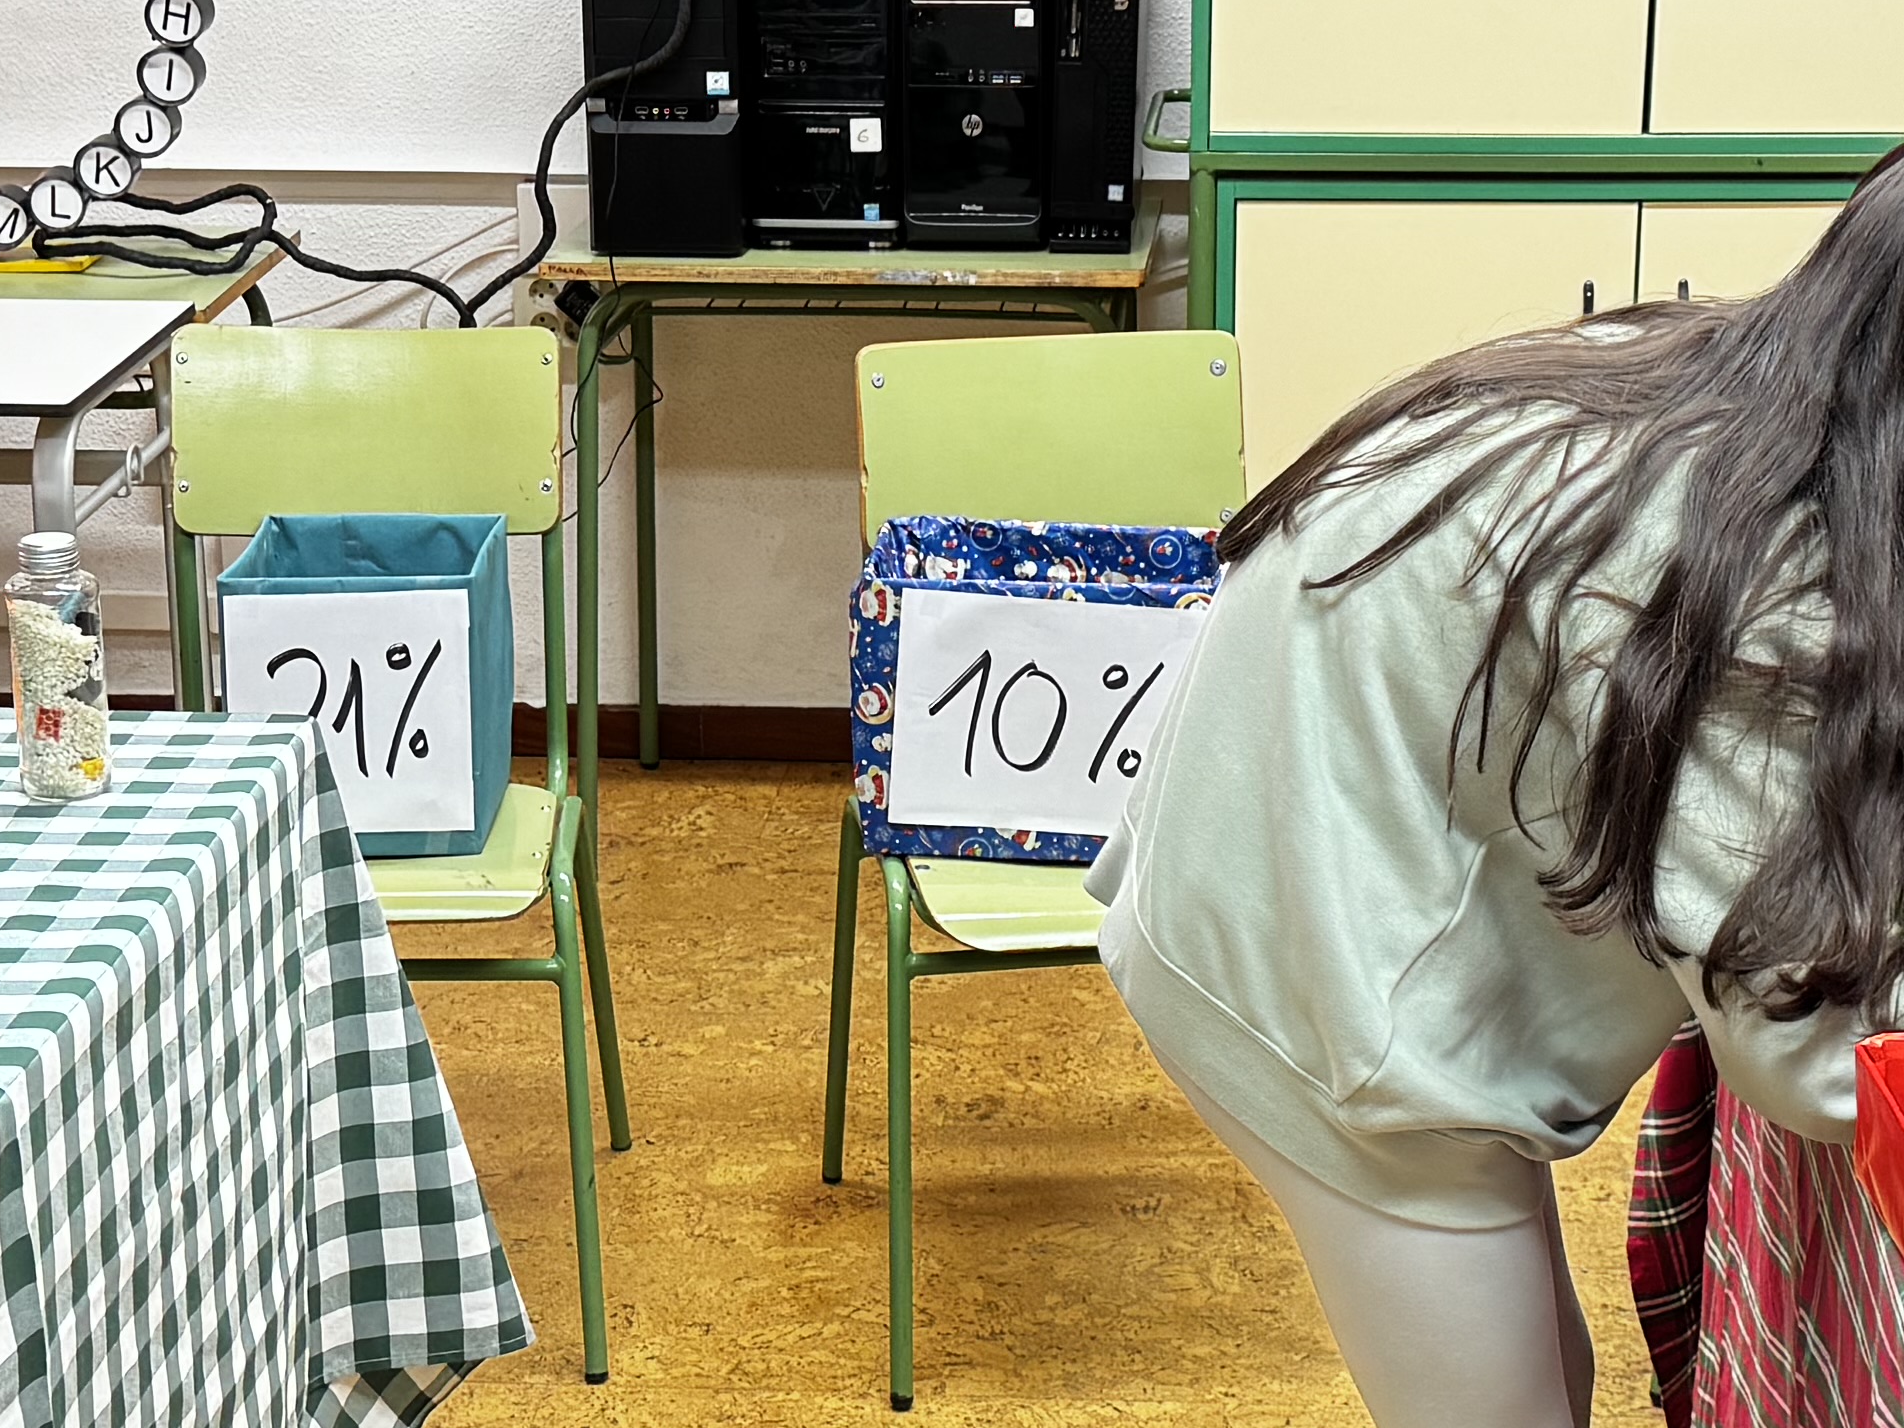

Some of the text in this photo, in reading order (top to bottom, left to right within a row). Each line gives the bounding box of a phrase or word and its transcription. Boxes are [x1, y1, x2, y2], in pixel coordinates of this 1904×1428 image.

[135, 109, 153, 144] J
[94, 151, 121, 188] K
[50, 184, 71, 220] L
[929, 649, 1164, 783] 10%
